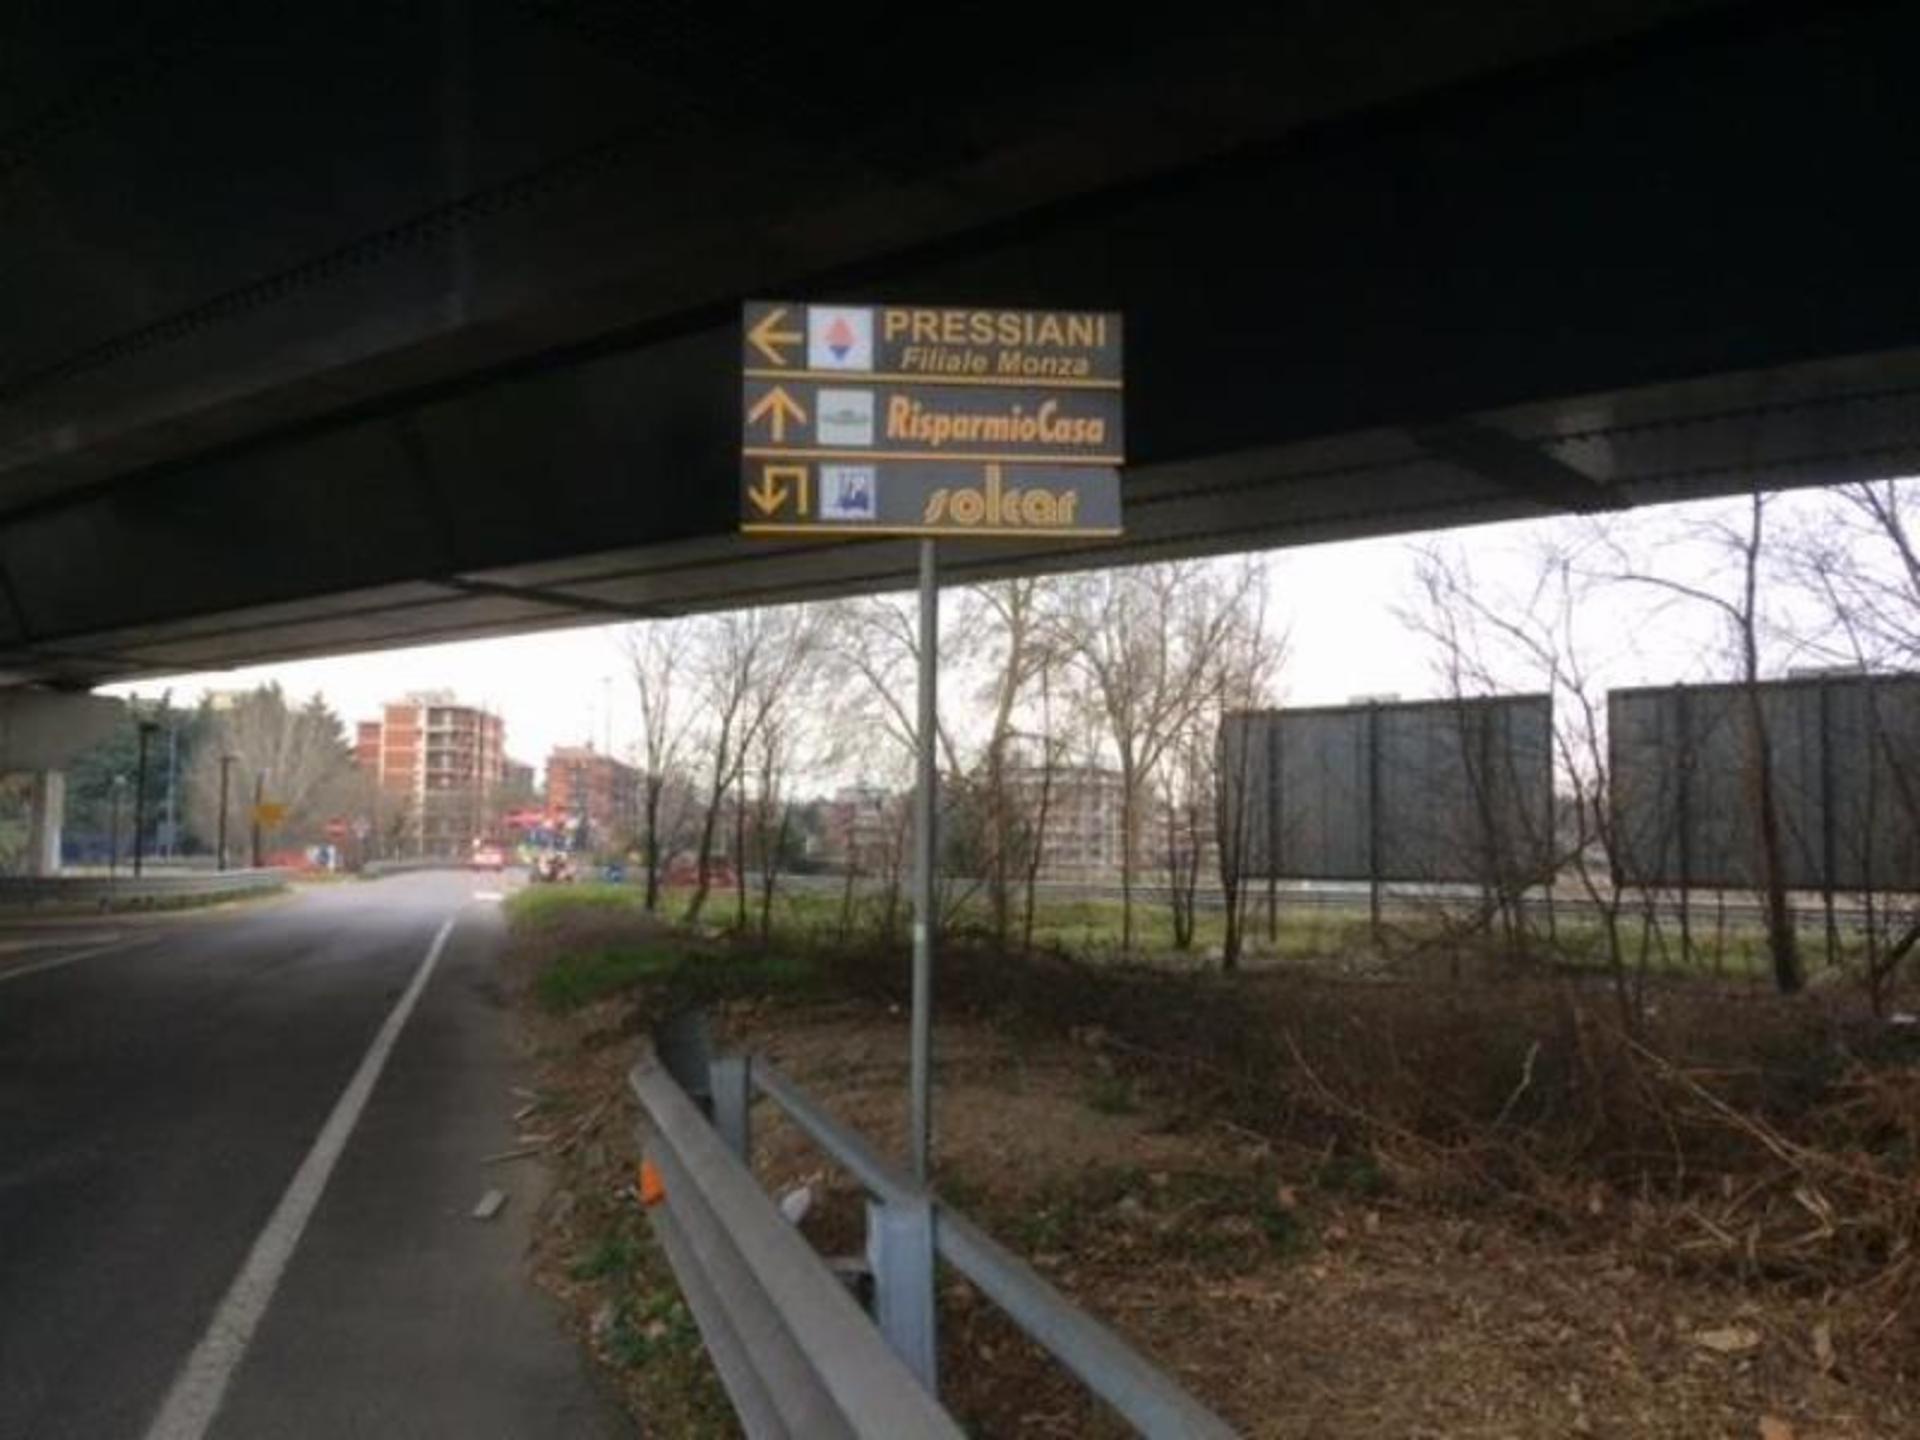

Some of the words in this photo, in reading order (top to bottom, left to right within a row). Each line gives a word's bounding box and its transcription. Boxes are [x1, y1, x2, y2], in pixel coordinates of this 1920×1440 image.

[884, 310, 1106, 346] PRESSIANI
[901, 347, 989, 374] Filiale
[997, 351, 1090, 376] Monza
[887, 395, 1105, 446] RisparmioCasa
